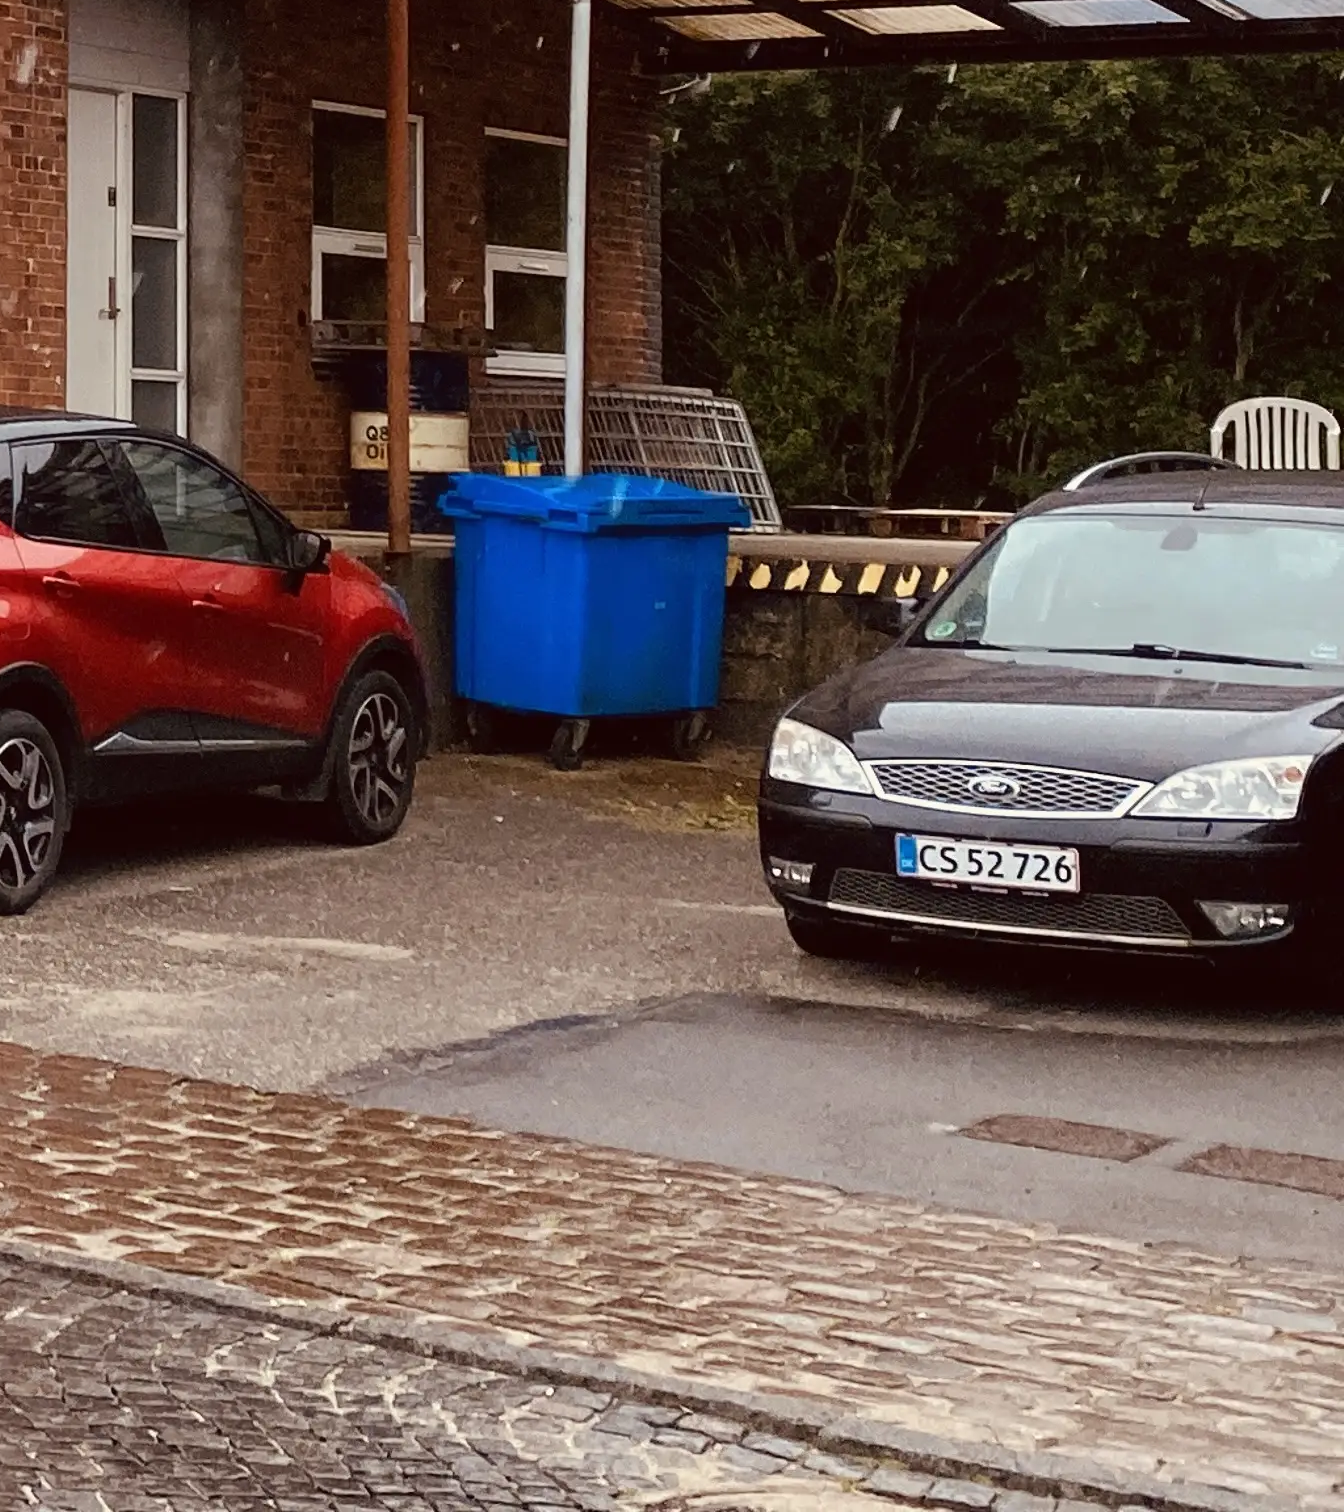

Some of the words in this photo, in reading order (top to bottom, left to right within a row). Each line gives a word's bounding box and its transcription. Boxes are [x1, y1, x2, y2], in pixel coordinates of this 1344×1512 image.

[366, 444, 385, 460] Oi
[918, 845, 959, 874] CS
[967, 848, 1005, 878] 52
[1012, 852, 1073, 883] 726
